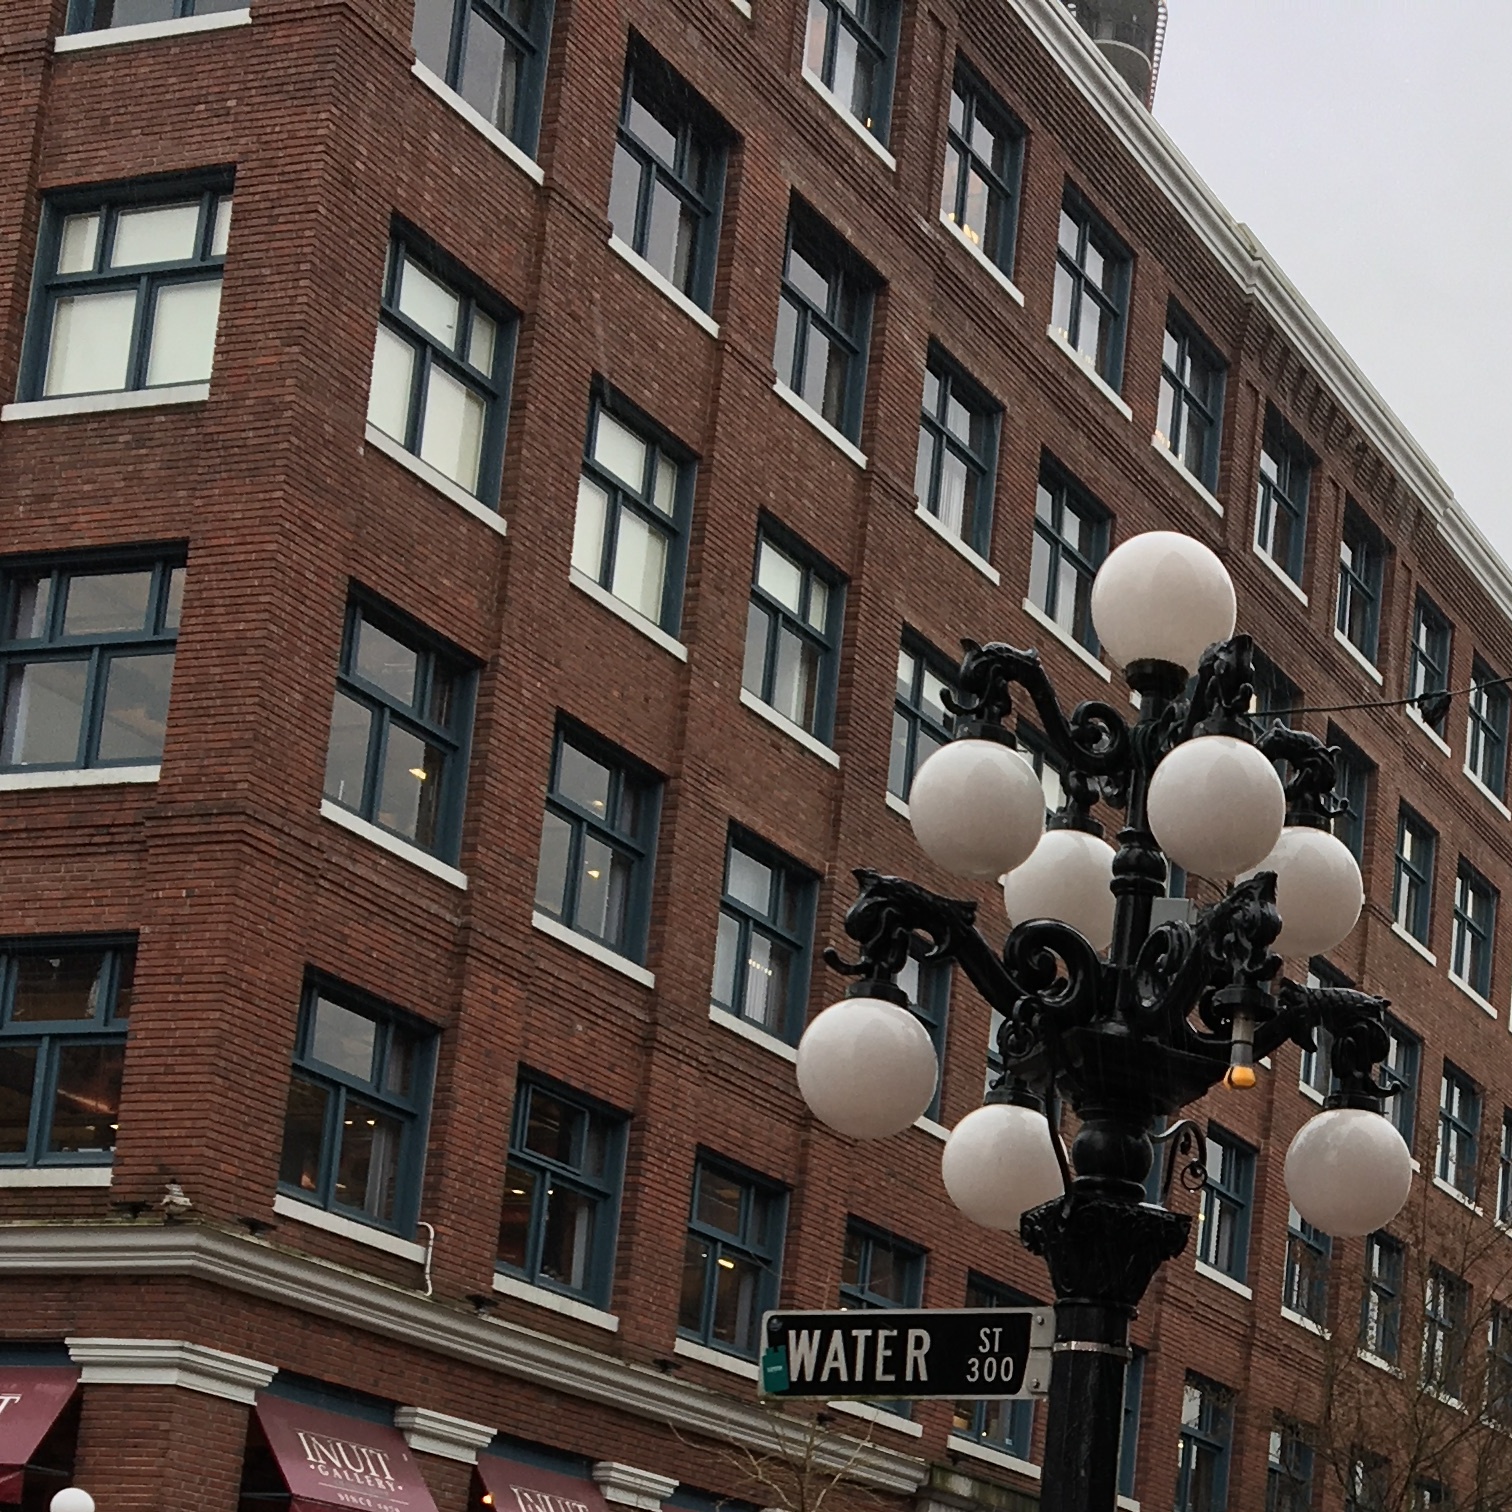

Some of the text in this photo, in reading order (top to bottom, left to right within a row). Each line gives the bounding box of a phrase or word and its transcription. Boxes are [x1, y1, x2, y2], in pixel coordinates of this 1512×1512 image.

[788, 1327, 1003, 1382] WATER ST
[966, 1357, 1014, 1382] 300
[298, 1432, 394, 1481] INUIT
[318, 1465, 395, 1492] GALLERY
